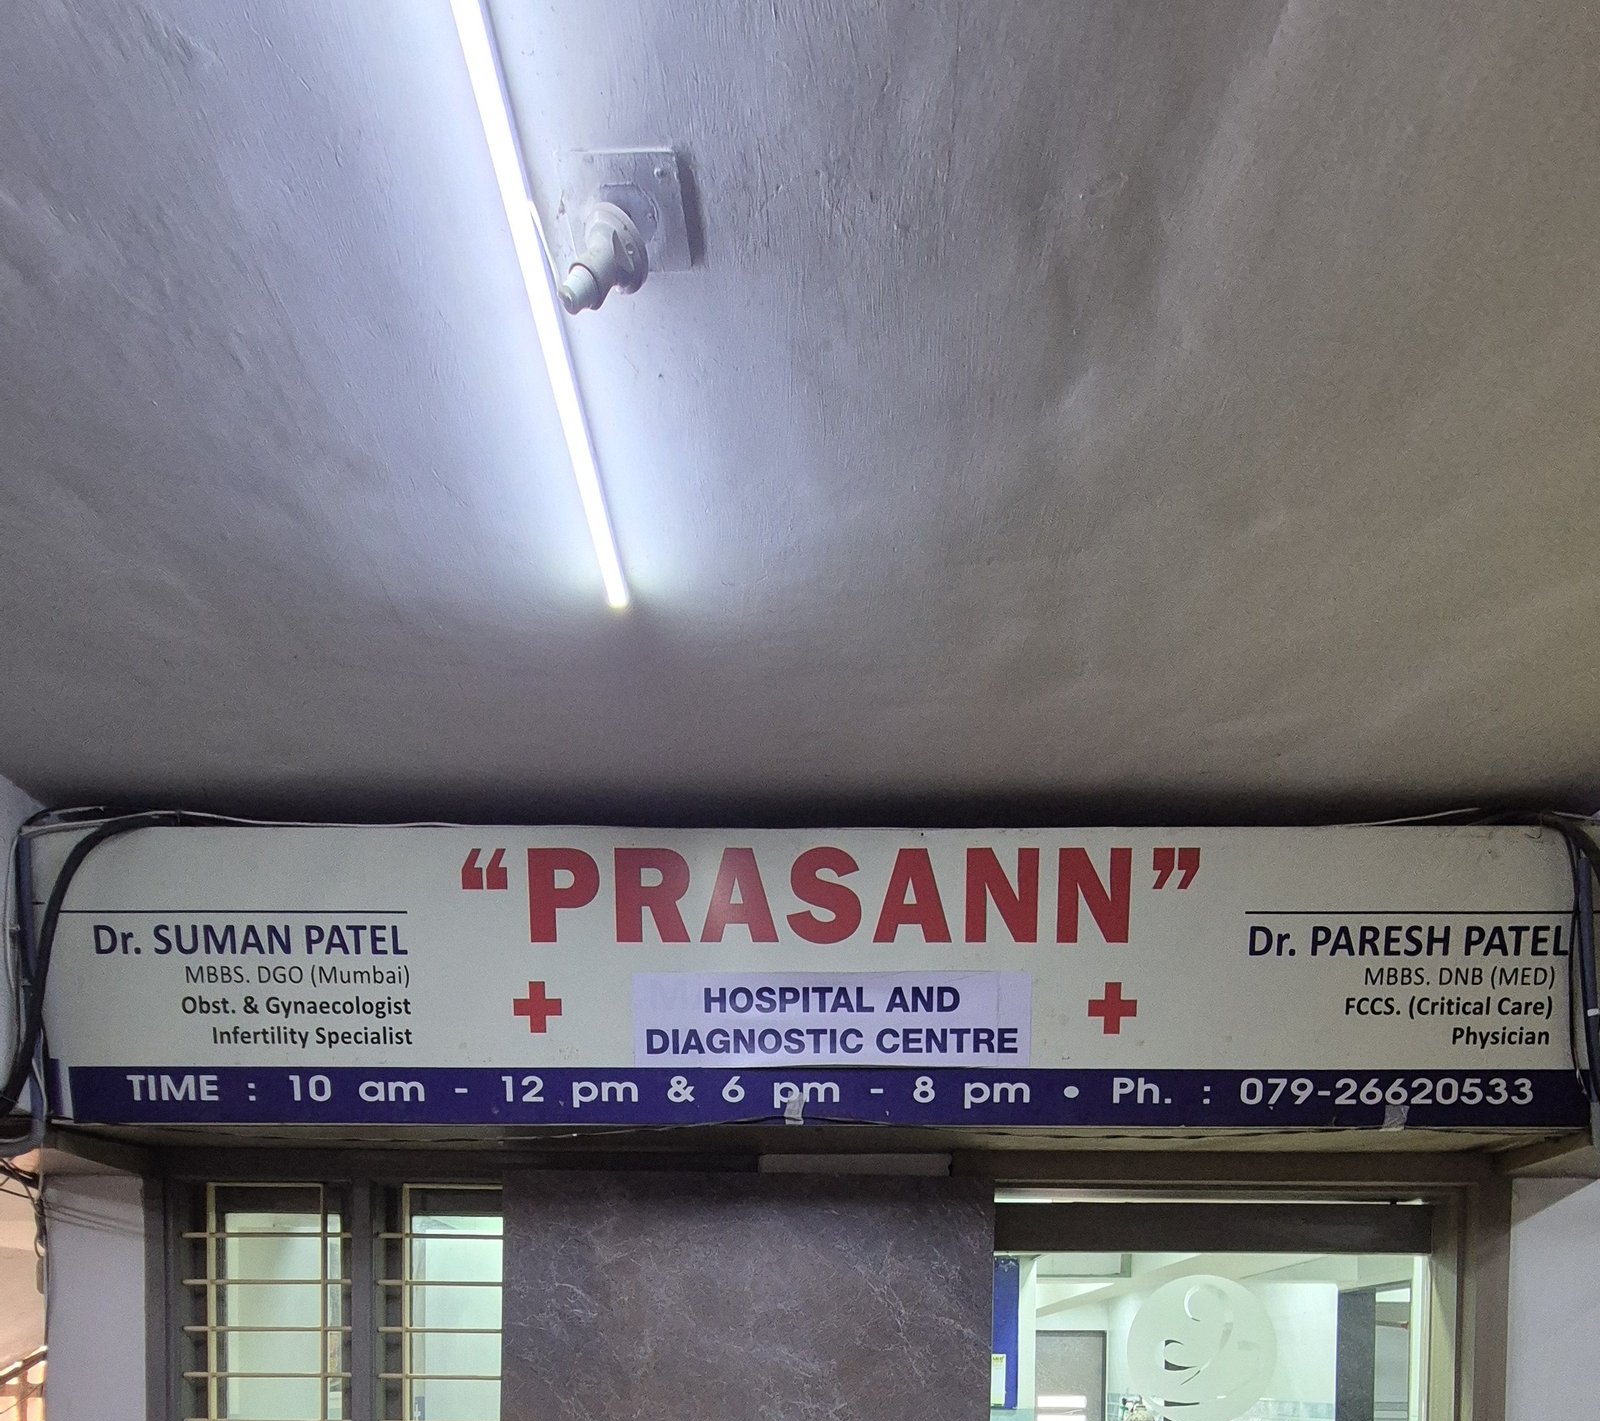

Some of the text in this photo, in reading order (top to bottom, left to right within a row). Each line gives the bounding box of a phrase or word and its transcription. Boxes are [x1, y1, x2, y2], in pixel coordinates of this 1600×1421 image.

[94, 924, 408, 955] Dr. SUMAN PATEL
[1249, 925, 1569, 956] Dr. PARESH PATEL
[186, 965, 409, 988] MBBS. DGO (Mumbai)
[1365, 966, 1555, 990] MBBS. DNB (MED)
[182, 996, 411, 1018] Obst. & Gynaecologist
[704, 987, 874, 1013] HOSPITAL
[886, 986, 960, 1012] AND
[1346, 996, 1552, 1019] FCCS. (Critical Care)
[213, 1026, 412, 1048] Infertility Specialist
[646, 1028, 1018, 1054] DIAGNOSTIC CENTRE
[1452, 1026, 1549, 1047] Physician
[127, 1075, 219, 1101] TIME
[289, 1075, 331, 1101] 10
[359, 1081, 425, 1101] am
[502, 1076, 544, 1102] 12
[573, 1082, 638, 1107] pm
[667, 1076, 694, 1102] &
[722, 1076, 745, 1102] 6
[774, 1082, 840, 1108] pm
[913, 1076, 935, 1103] 8
[965, 1083, 1030, 1109] pm
[1113, 1078, 1171, 1103] Ph.
[1240, 1077, 1534, 1105] 079-26620533
